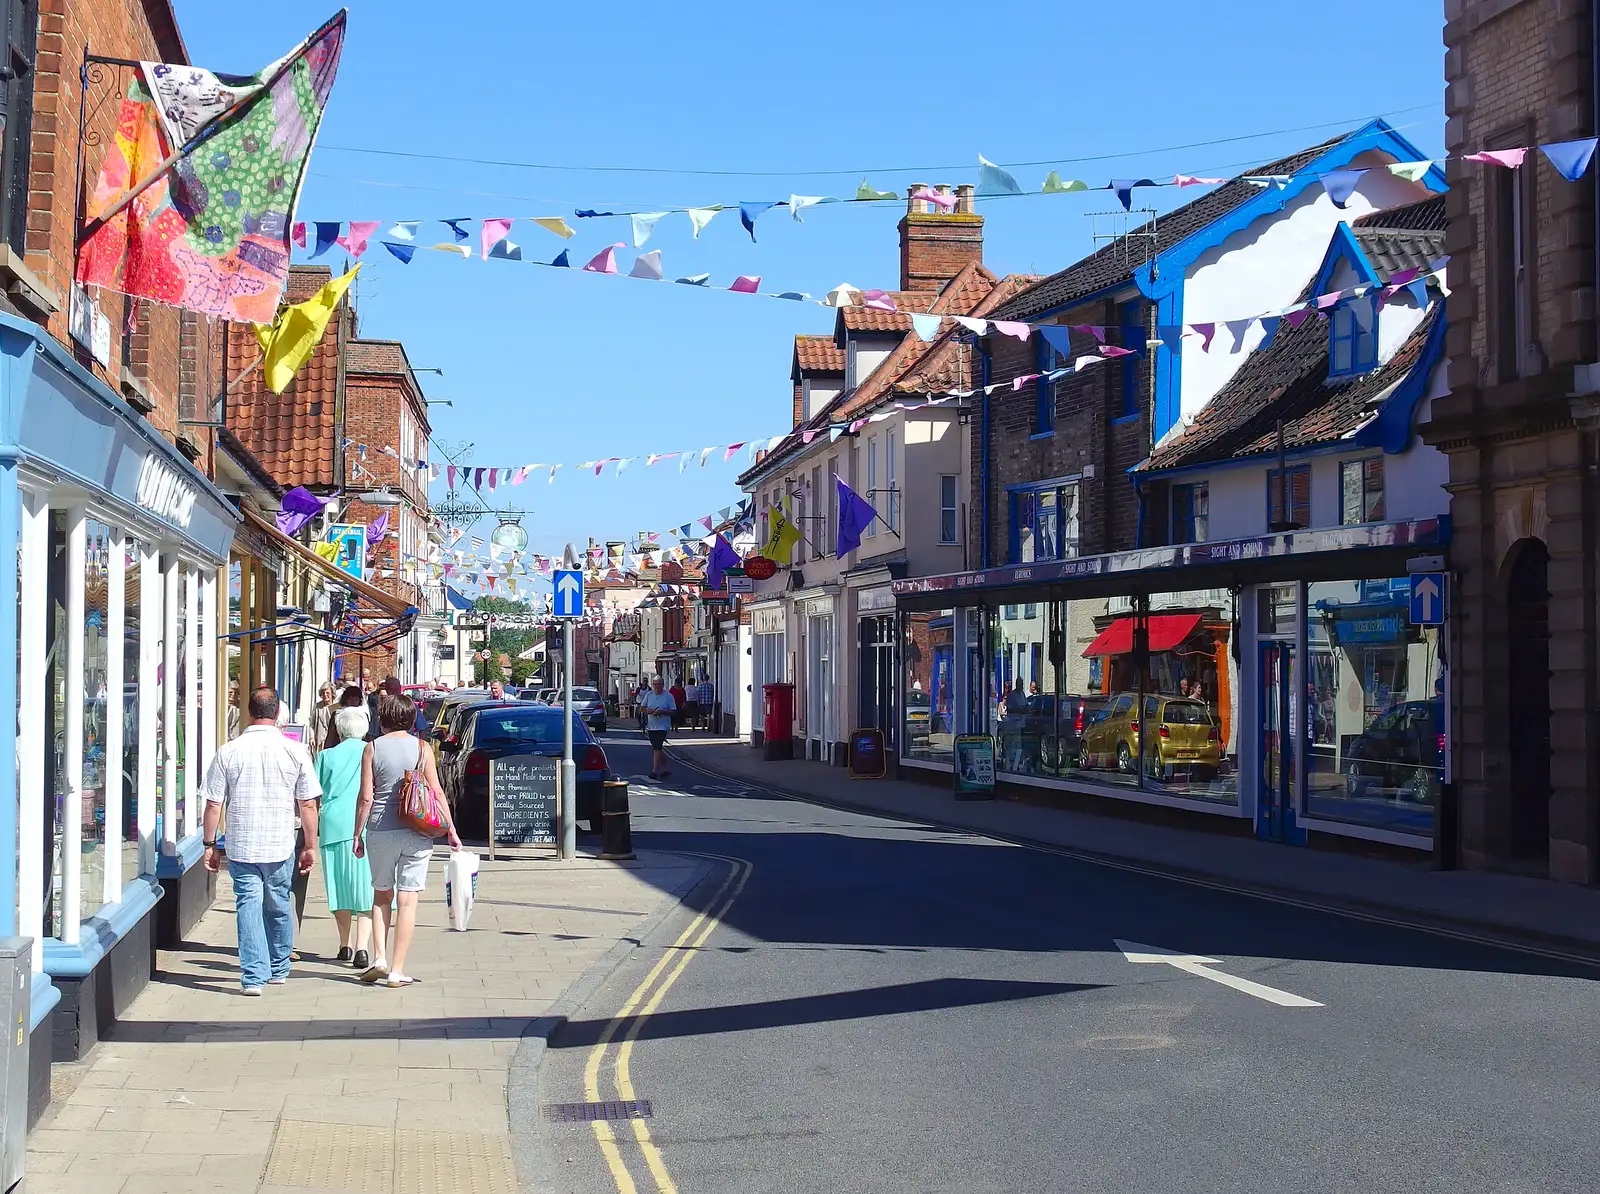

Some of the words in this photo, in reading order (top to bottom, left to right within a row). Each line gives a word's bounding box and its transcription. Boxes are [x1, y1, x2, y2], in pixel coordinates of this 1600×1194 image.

[1211, 546, 1226, 558] SIGHT
[1228, 544, 1240, 556] AND
[1242, 542, 1263, 554] SOUND
[1065, 563, 1077, 574] SIGHT
[1078, 561, 1087, 571] AND
[496, 763, 508, 771] All
[505, 773, 520, 781] Hand
[538, 773, 552, 781] here
[494, 783, 505, 791] the
[496, 792, 506, 800] We
[519, 791, 538, 800] PROUD
[539, 792, 546, 800] to
[518, 801, 545, 809] Sourced
[502, 811, 550, 820] INGREDIENTS
[494, 820, 510, 828] Come
[534, 820, 552, 828] drink
[494, 827, 506, 835] and
[513, 835, 523, 843] EAT
